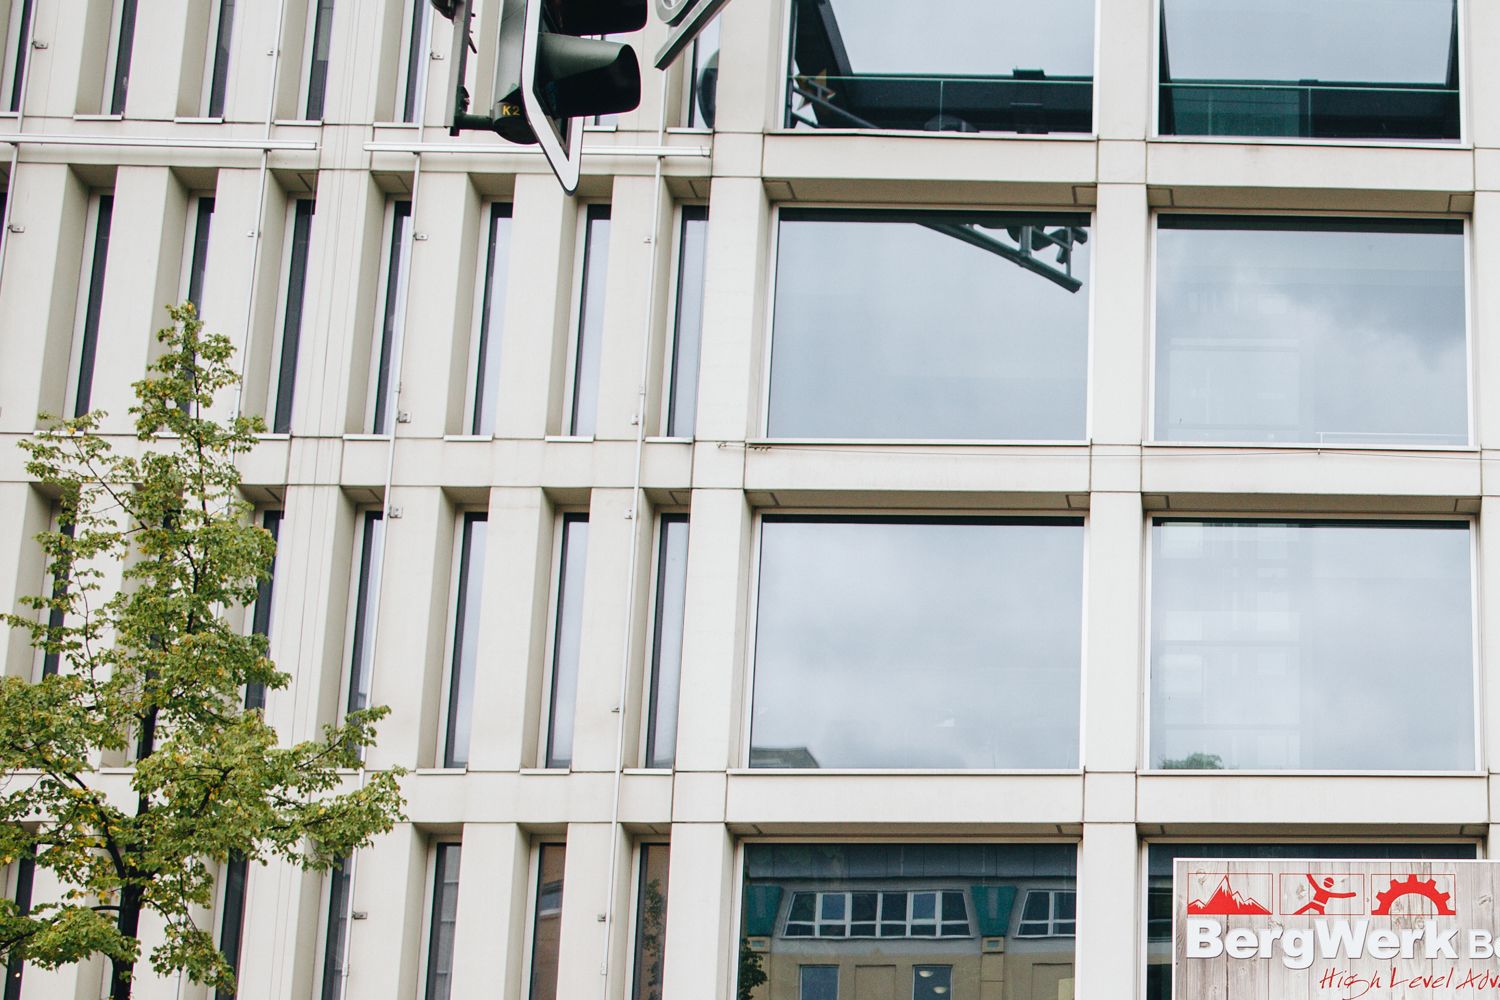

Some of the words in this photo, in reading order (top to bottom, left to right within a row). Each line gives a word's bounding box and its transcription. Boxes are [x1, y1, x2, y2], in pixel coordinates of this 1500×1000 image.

[502, 104, 521, 116] K2
[1186, 918, 1460, 970] BergWerk
[1319, 967, 1382, 1000] High
[1389, 966, 1455, 990] Level
